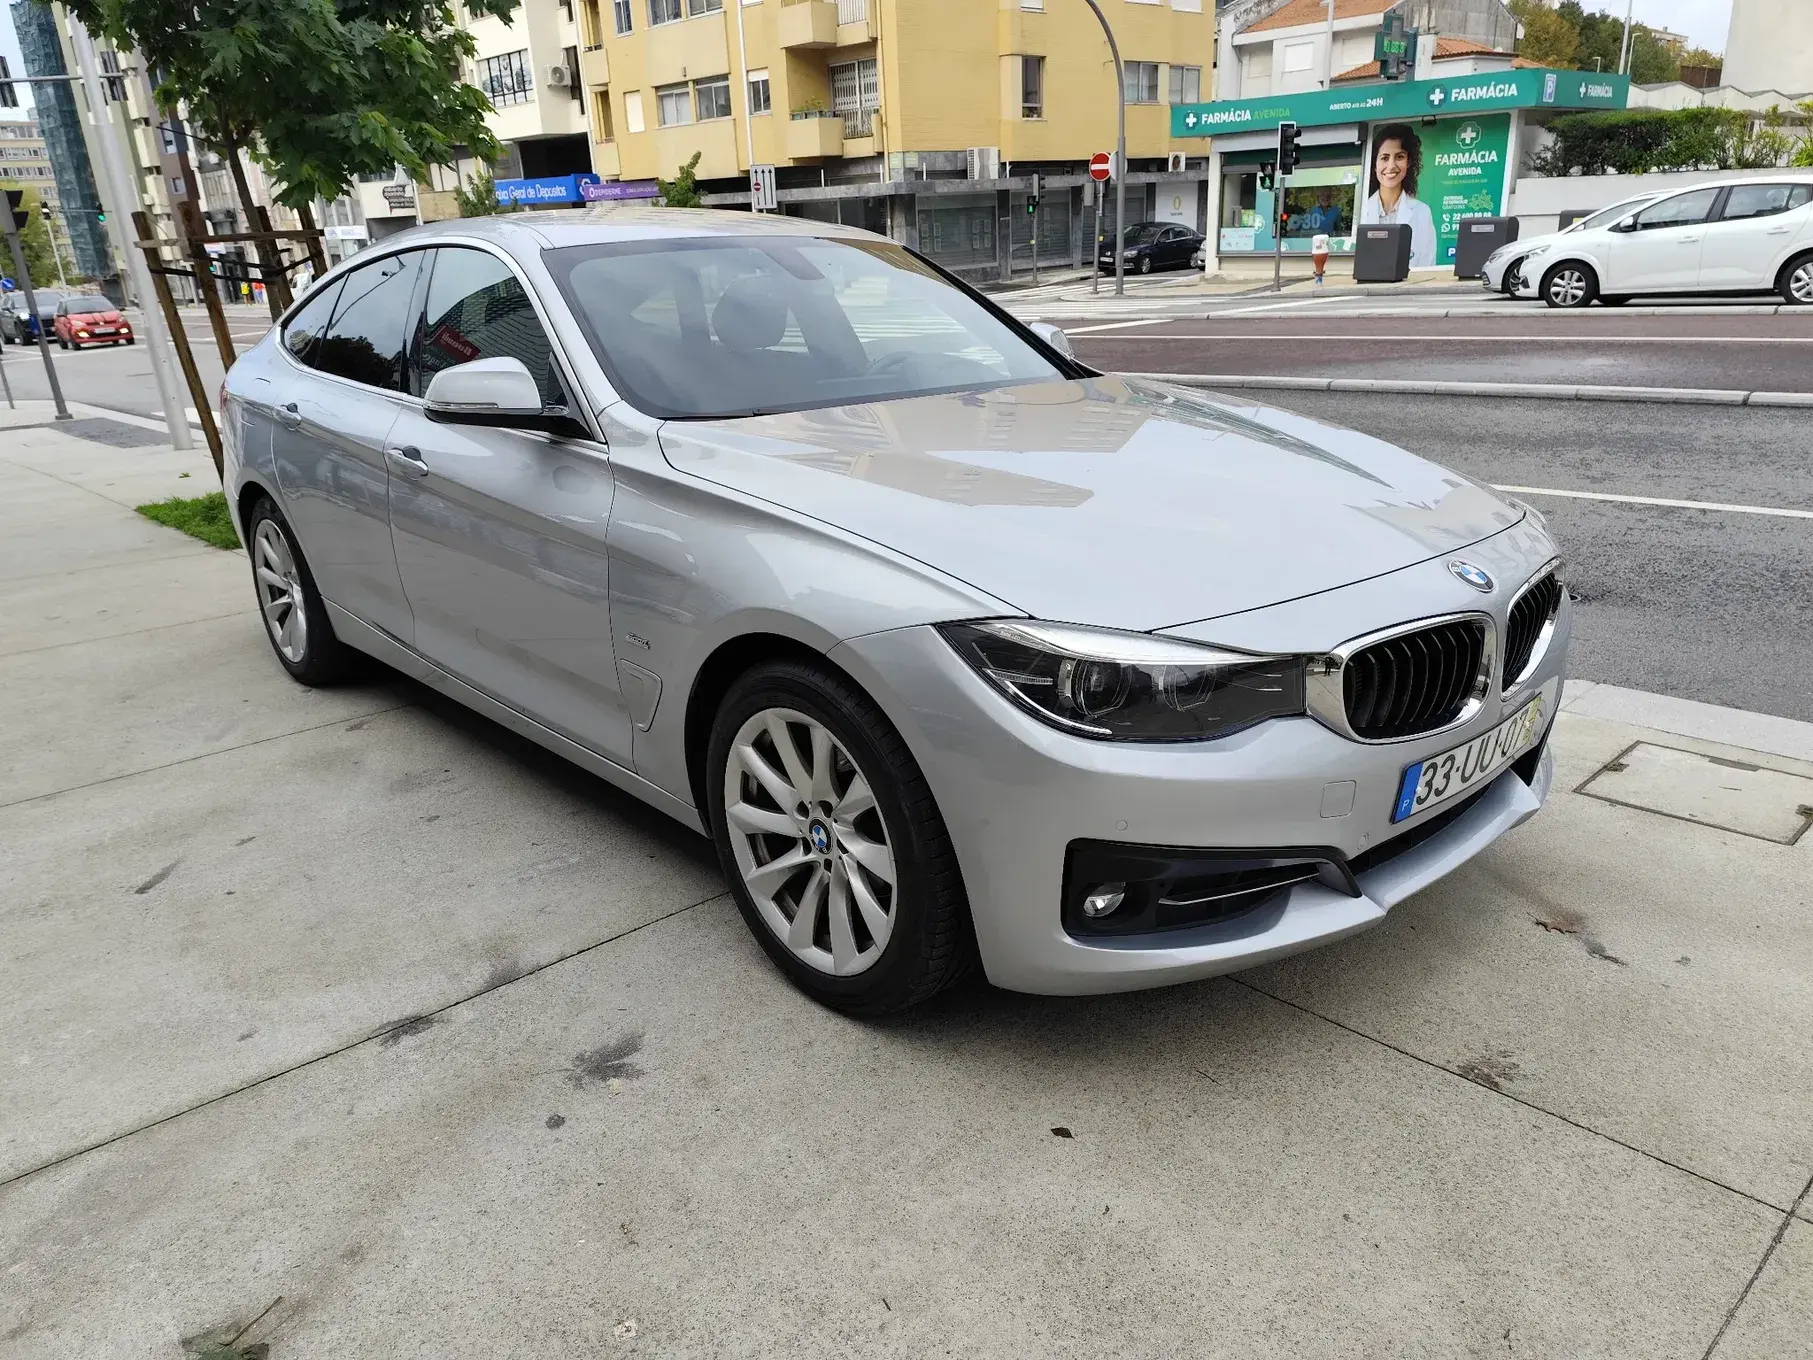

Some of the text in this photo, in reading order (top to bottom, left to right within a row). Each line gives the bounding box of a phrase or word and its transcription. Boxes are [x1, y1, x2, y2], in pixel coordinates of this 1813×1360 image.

[1451, 82, 1517, 101] FARMÁCIA
[1587, 82, 1613, 98] FARMÁCIA
[1329, 102, 1351, 111] ABERTO
[1366, 97, 1384, 107] 24H
[1201, 108, 1290, 125] FARMÁCIA AVENIDA
[1434, 150, 1498, 166] FARMÁCIA
[1448, 166, 1482, 176] AVENIDA
[508, 185, 526, 199] Geral
[526, 185, 536, 199] de
[1452, 212, 1461, 221] 22
[1401, 799, 1410, 812] P
